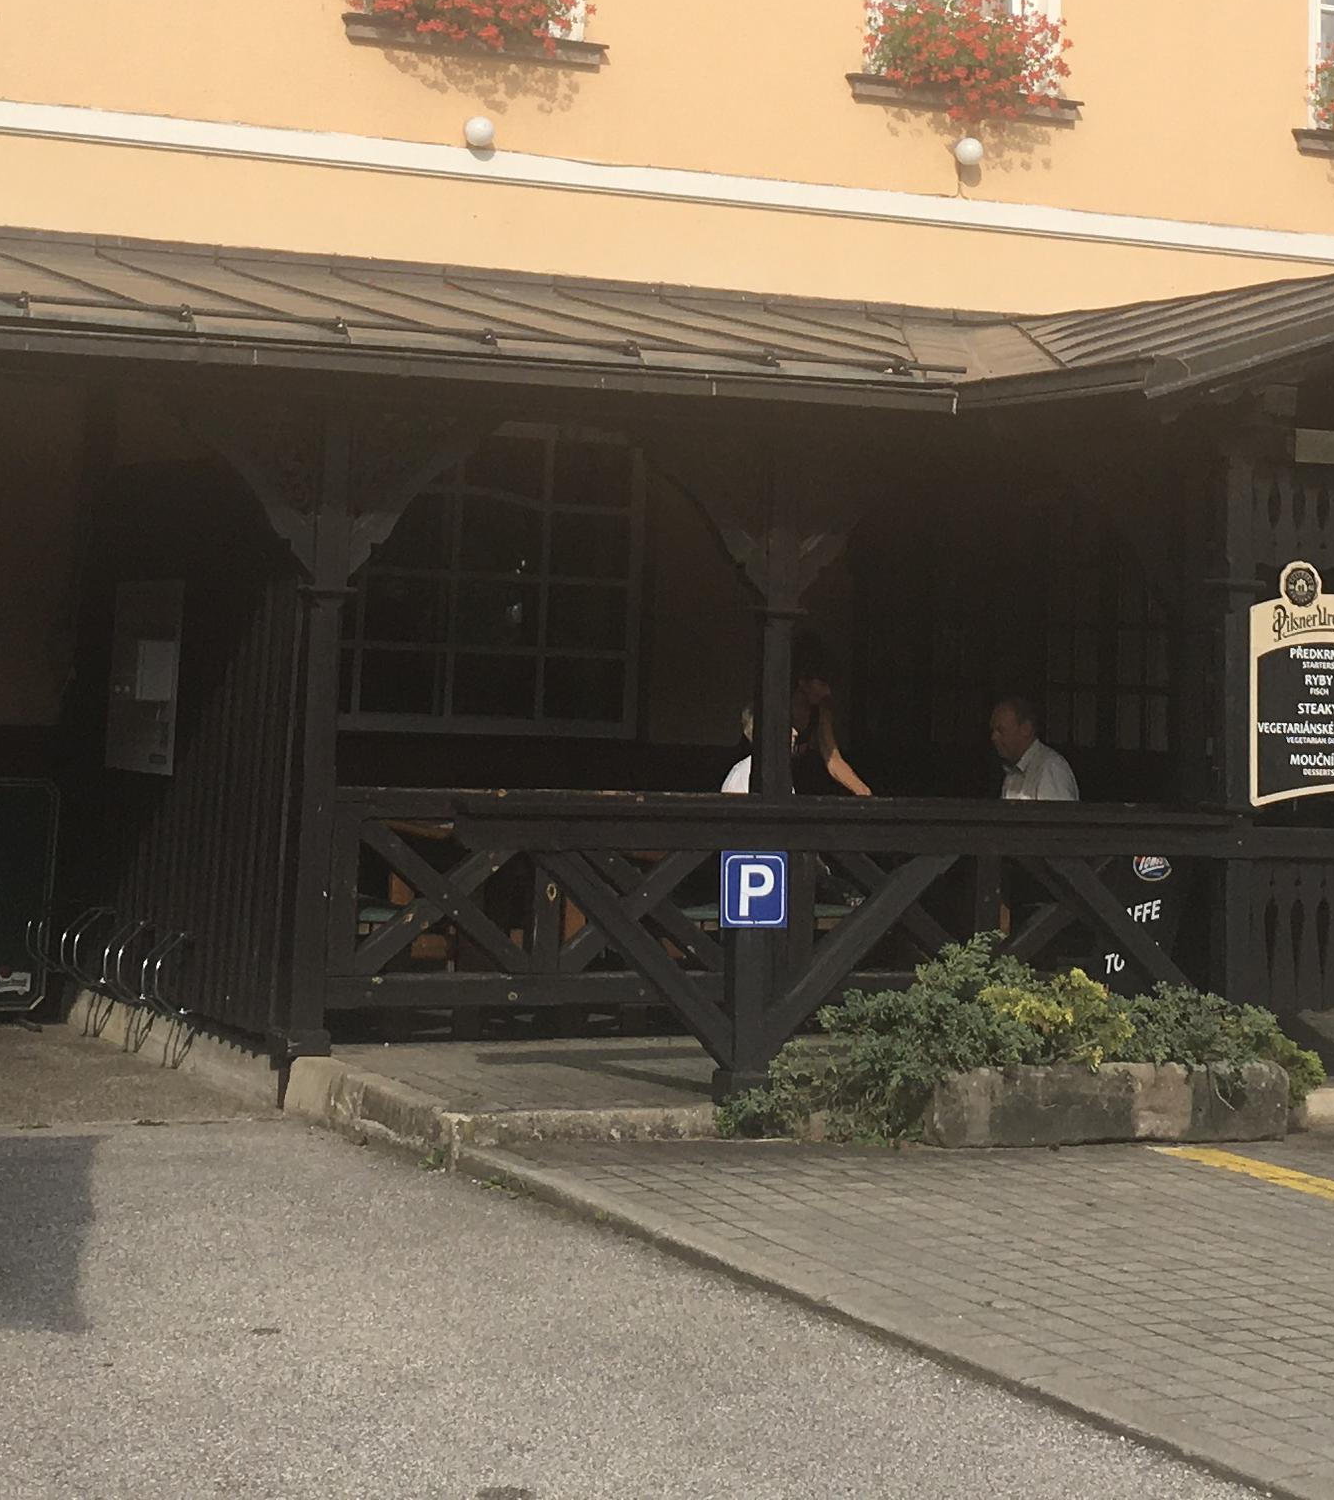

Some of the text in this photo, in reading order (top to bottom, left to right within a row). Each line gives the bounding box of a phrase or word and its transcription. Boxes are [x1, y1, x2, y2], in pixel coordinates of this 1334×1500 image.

[1272, 604, 1317, 642] Pilsner
[1302, 661, 1334, 670] STARTERS
[1304, 674, 1333, 686] RYBY
[1257, 720, 1334, 735] VEGETARIÁNSKÉ
[739, 864, 775, 917] P
